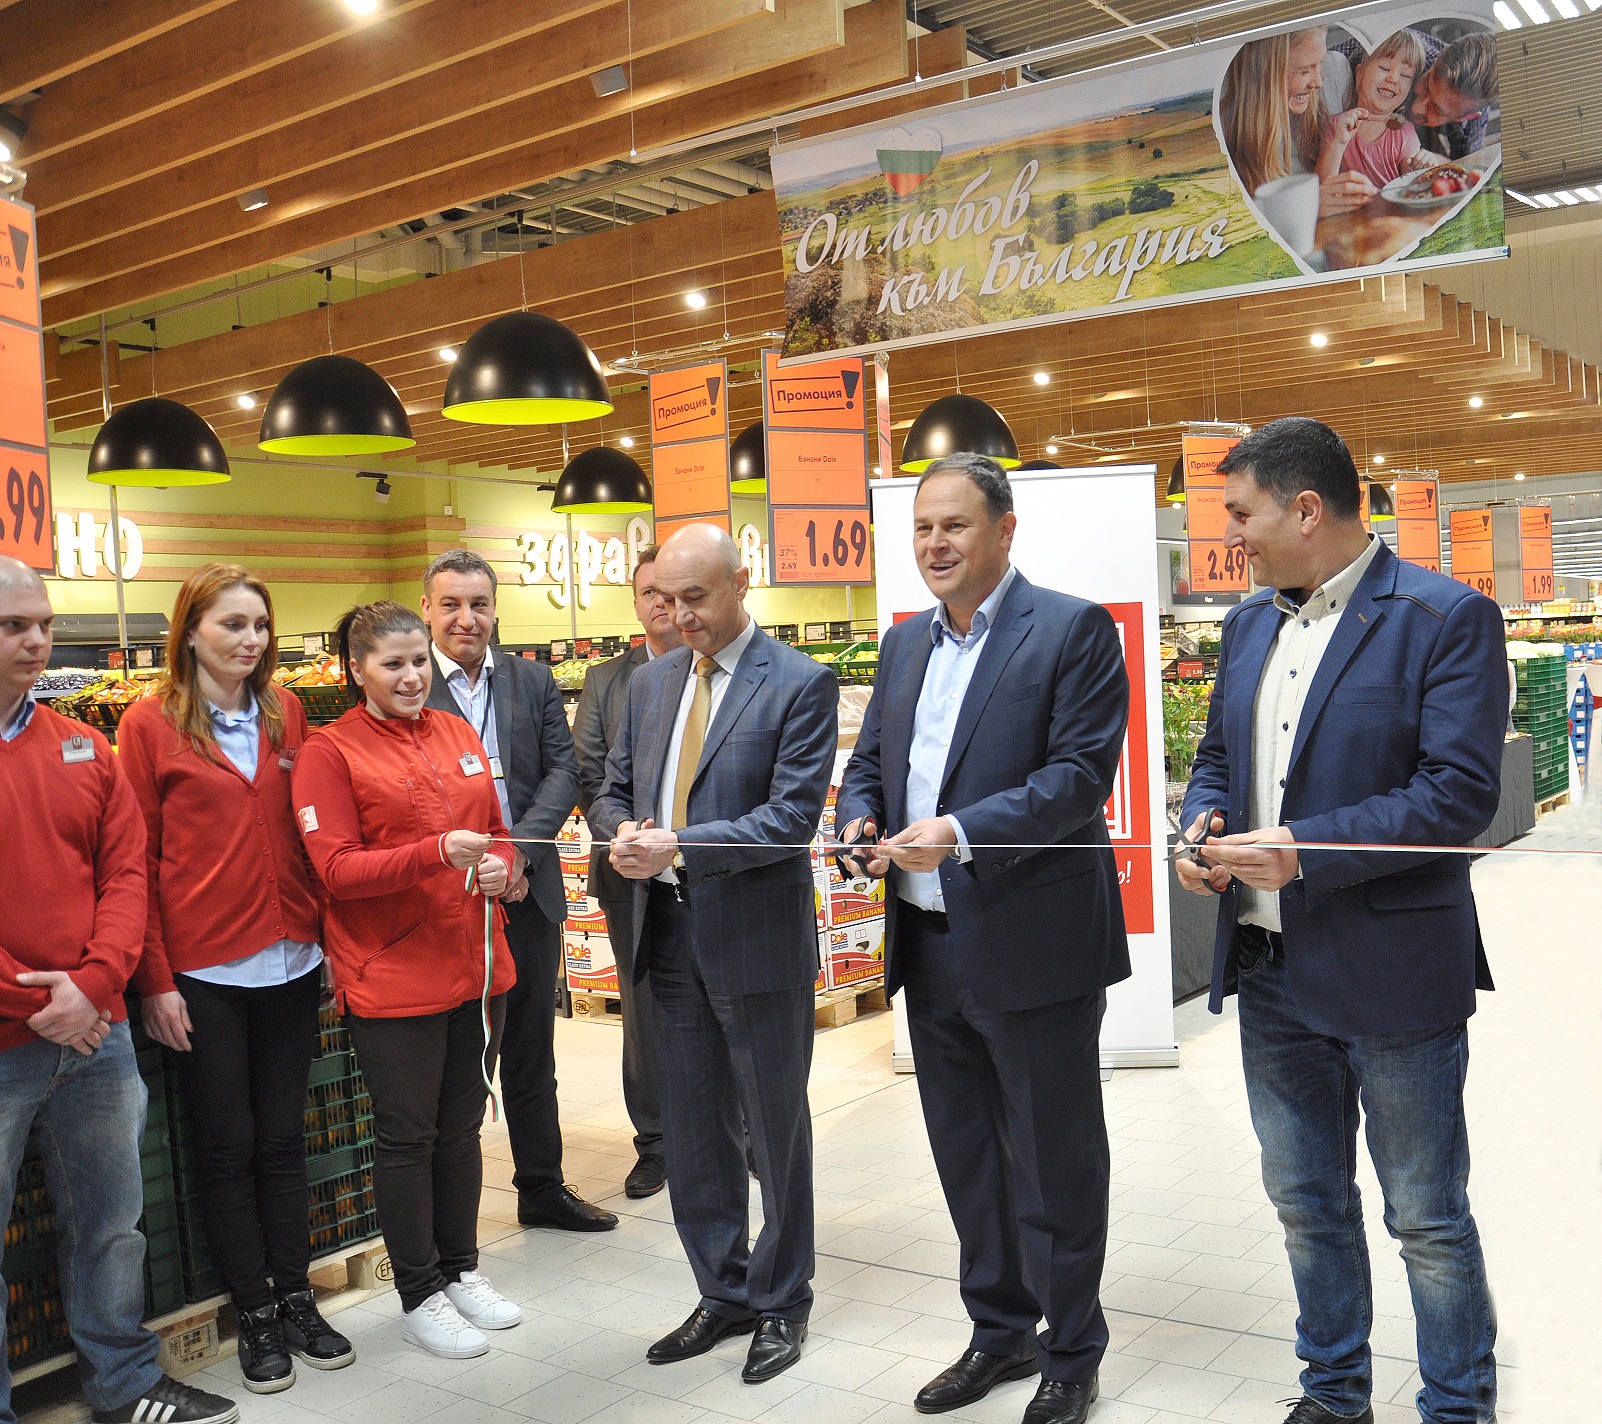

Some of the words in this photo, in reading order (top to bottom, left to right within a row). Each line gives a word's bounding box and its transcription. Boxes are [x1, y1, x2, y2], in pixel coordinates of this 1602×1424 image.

[795, 212, 873, 274] От
[876, 159, 1039, 254] любов
[876, 265, 969, 315] към
[978, 218, 1230, 304] България
[777, 389, 842, 404] Промоция
[658, 398, 708, 420] Промоция
[779, 548, 798, 557] 37%
[805, 519, 867, 568] 1.69
[781, 562, 797, 570] 2.69
[1207, 549, 1246, 581] 2.49
[1532, 575, 1552, 594] 1.99
[567, 864, 589, 872] PREMI
[833, 910, 861, 924] PREMIUM
[862, 905, 885, 917] BANANA
[575, 921, 605, 931] PREMIUM
[830, 931, 848, 944] Dole
[566, 942, 592, 960] Dole
[835, 970, 864, 985] PREMIUM
[864, 964, 885, 977] BANAN
[578, 979, 608, 989] PREMIUM
